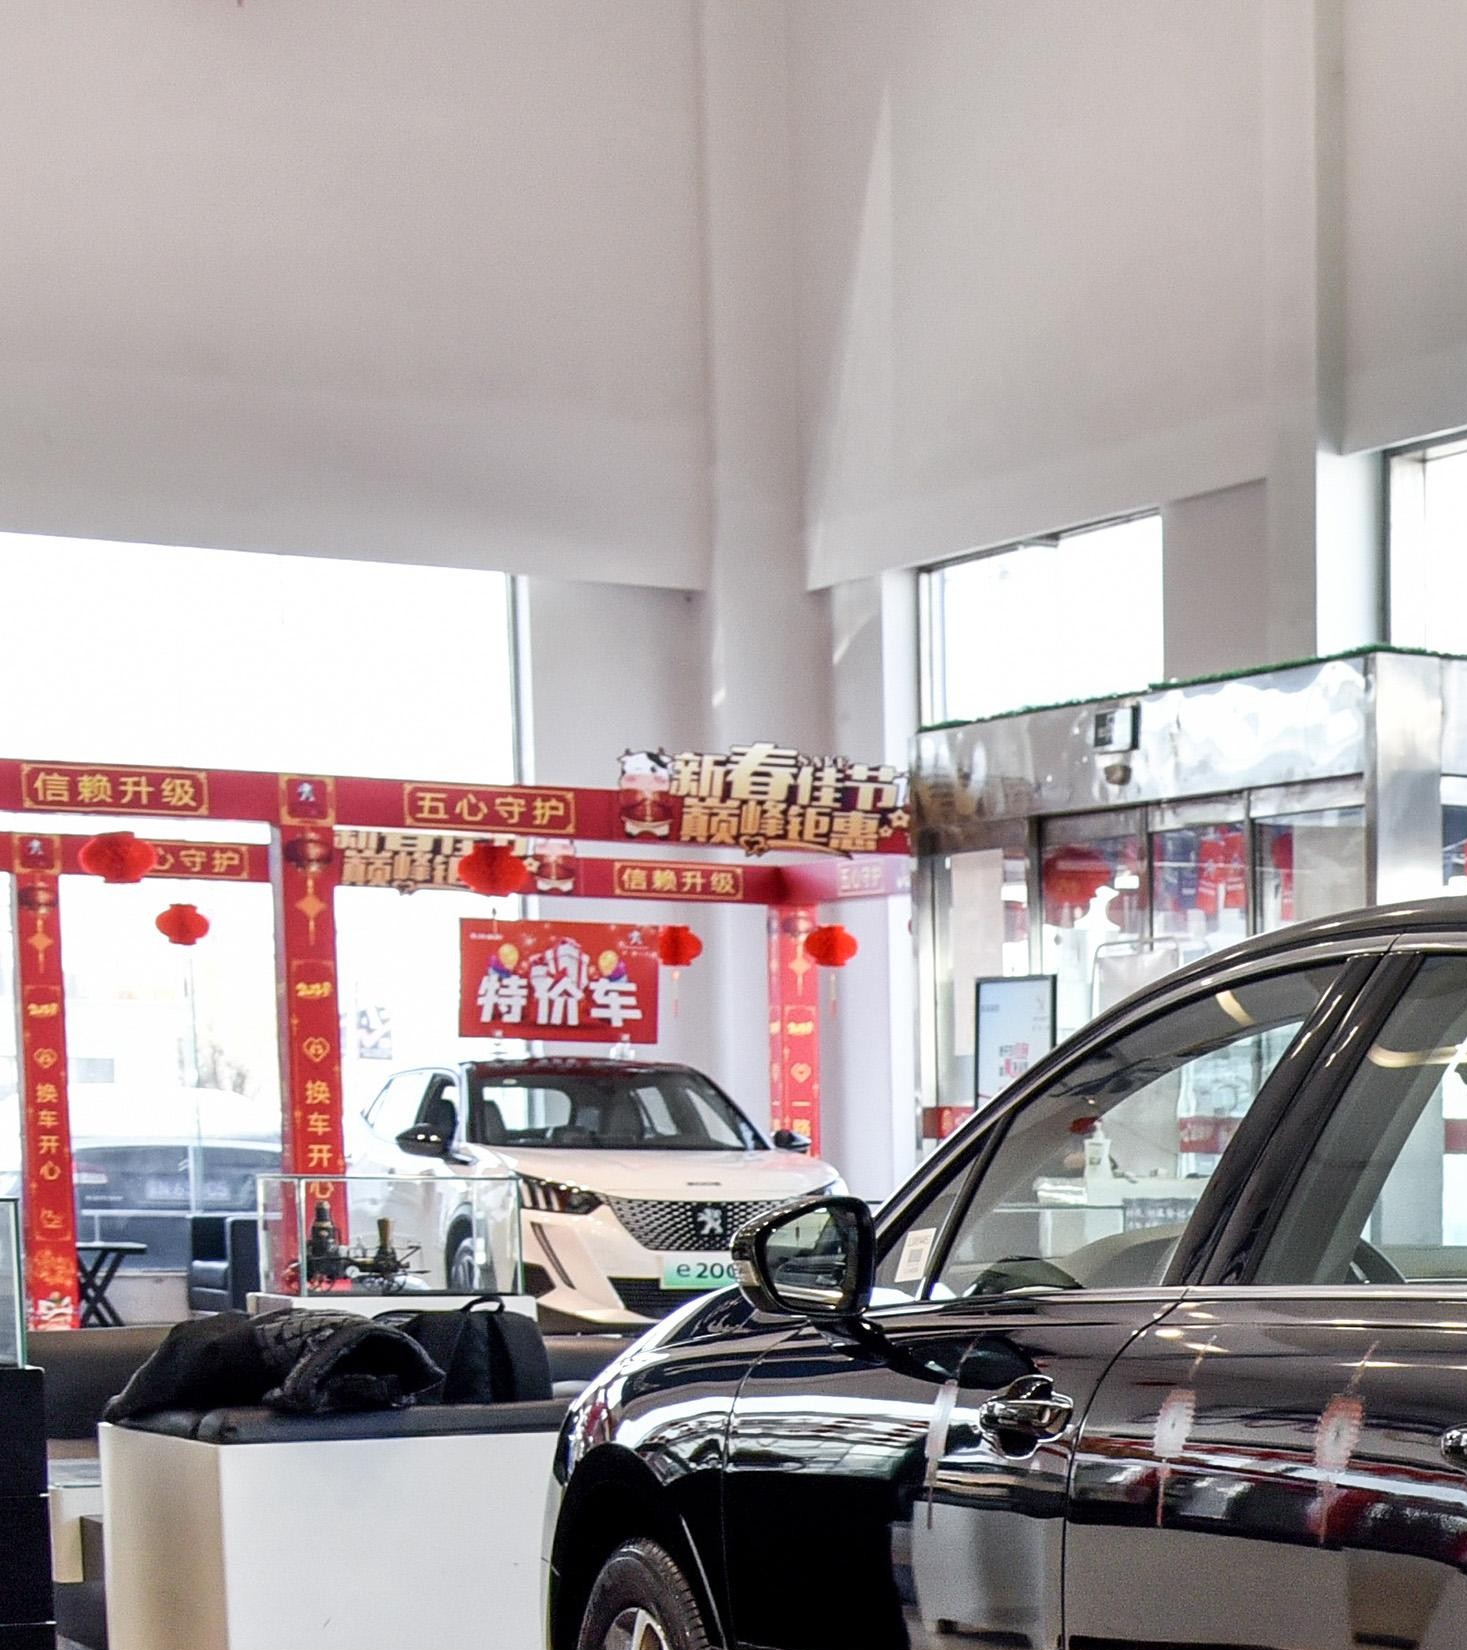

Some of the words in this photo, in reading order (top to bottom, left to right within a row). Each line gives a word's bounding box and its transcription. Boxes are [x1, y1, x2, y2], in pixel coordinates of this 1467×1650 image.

[33, 771, 198, 807] 信赖升级
[669, 741, 896, 809] 新春佳节
[415, 791, 565, 825] 五心守护
[679, 796, 881, 851] 巅峰钜惠
[150, 846, 241, 873] 心守护
[621, 868, 737, 894] 信赖升级
[476, 974, 643, 1028] 特价车
[35, 1082, 62, 1181] 换车开心
[304, 1079, 335, 1199] 换车开心
